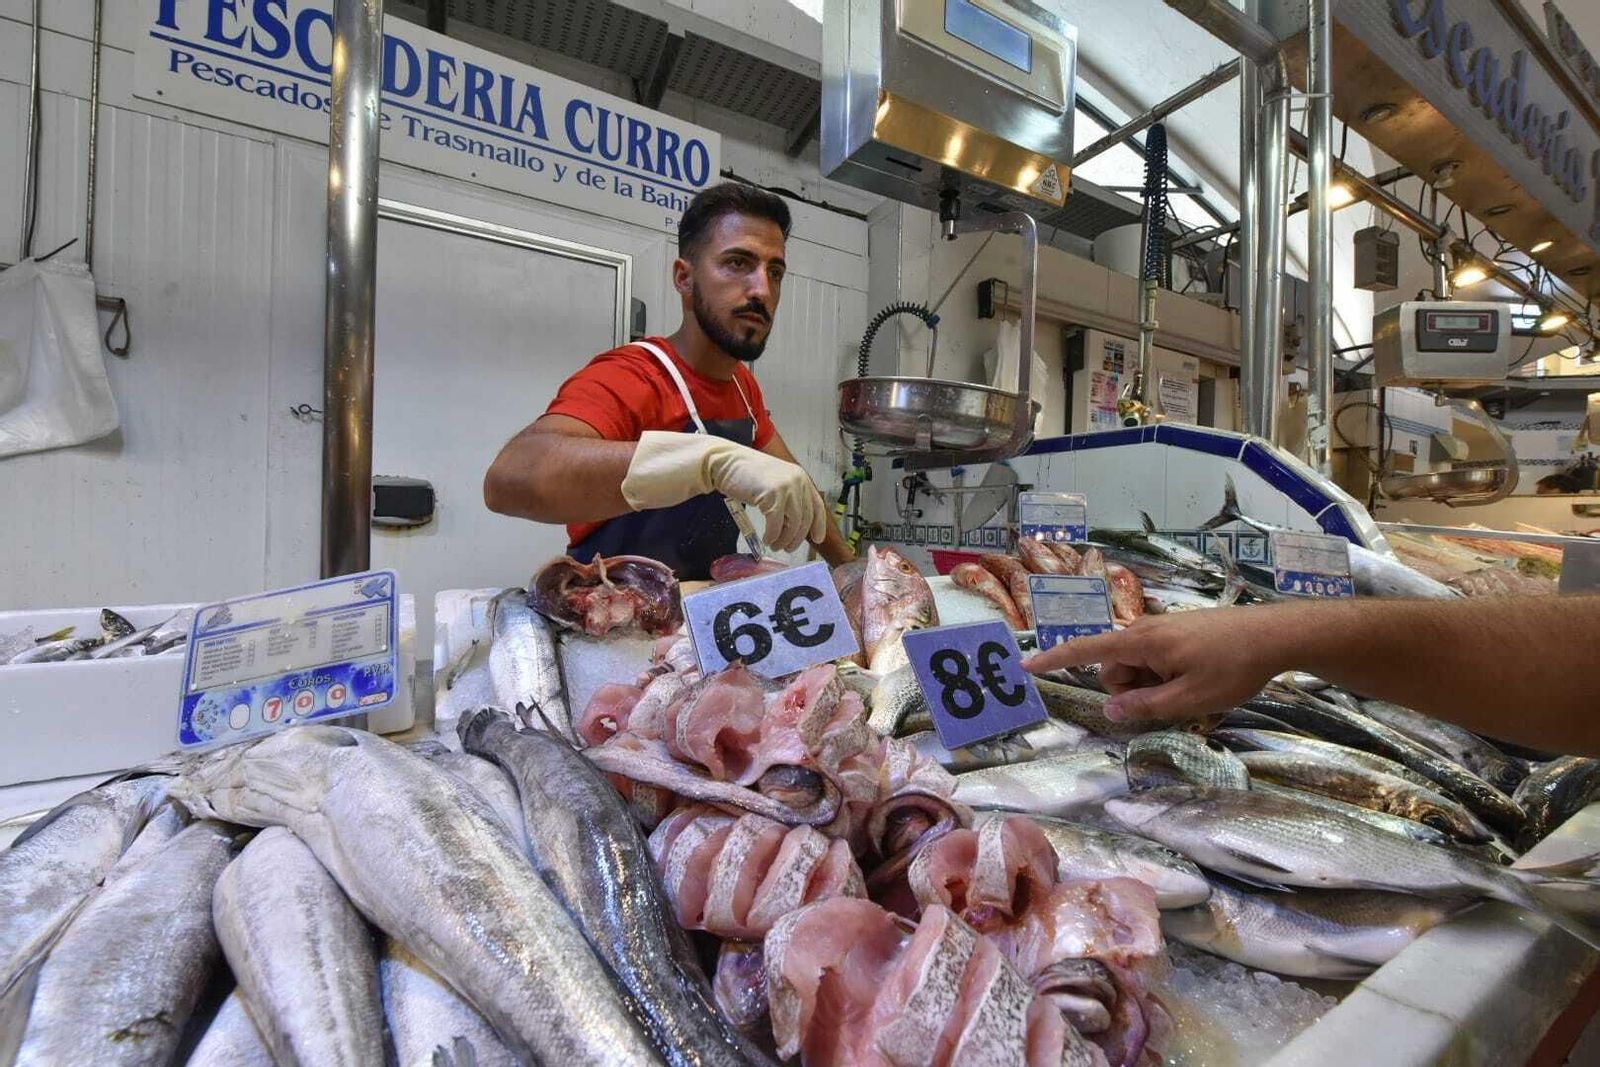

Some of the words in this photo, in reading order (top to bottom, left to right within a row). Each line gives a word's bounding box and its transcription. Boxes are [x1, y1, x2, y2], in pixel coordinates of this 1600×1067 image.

[155, 0, 549, 141] ESCDERIA
[564, 99, 711, 188] CURRO
[402, 114, 545, 172] Trasmallo
[553, 163, 568, 183] y
[576, 168, 606, 191] de
[614, 176, 633, 198] la
[641, 184, 689, 214] Bahi
[712, 585, 835, 665] 6€
[929, 641, 1027, 720] 8€
